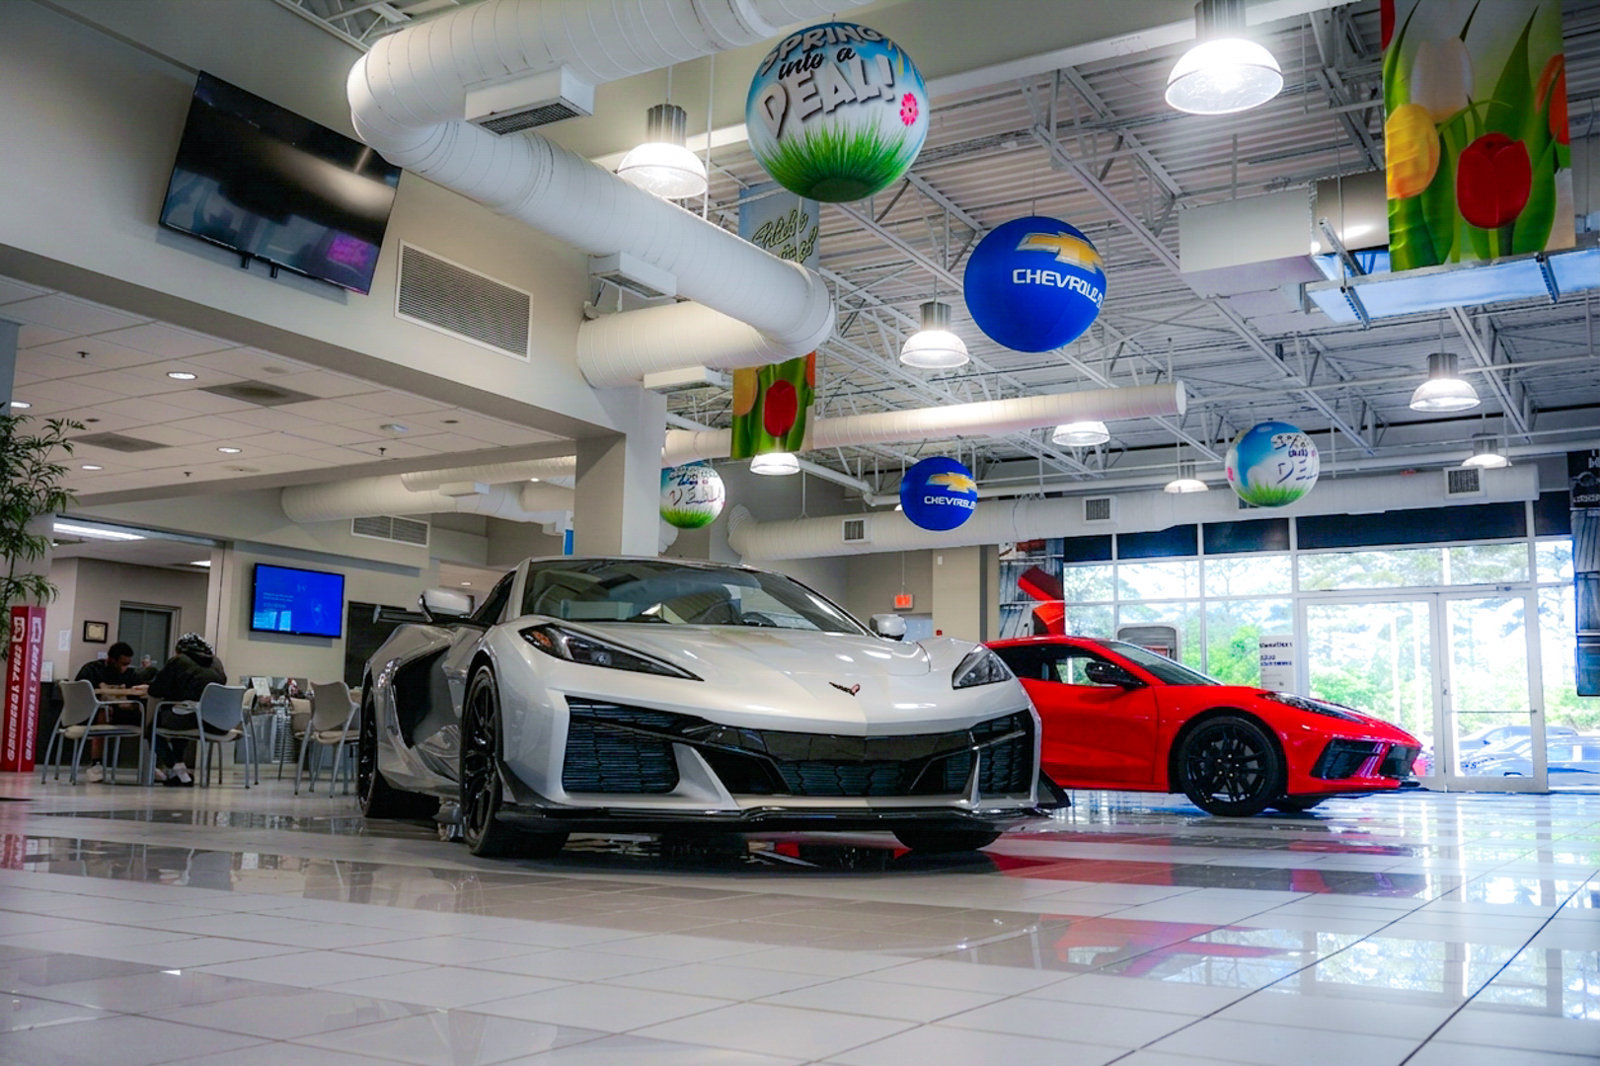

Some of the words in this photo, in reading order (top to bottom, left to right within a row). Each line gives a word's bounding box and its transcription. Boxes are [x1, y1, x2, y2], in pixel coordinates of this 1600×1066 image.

[778, 51, 825, 80] into
[836, 47, 856, 62] a
[758, 54, 895, 139] DEAL!
